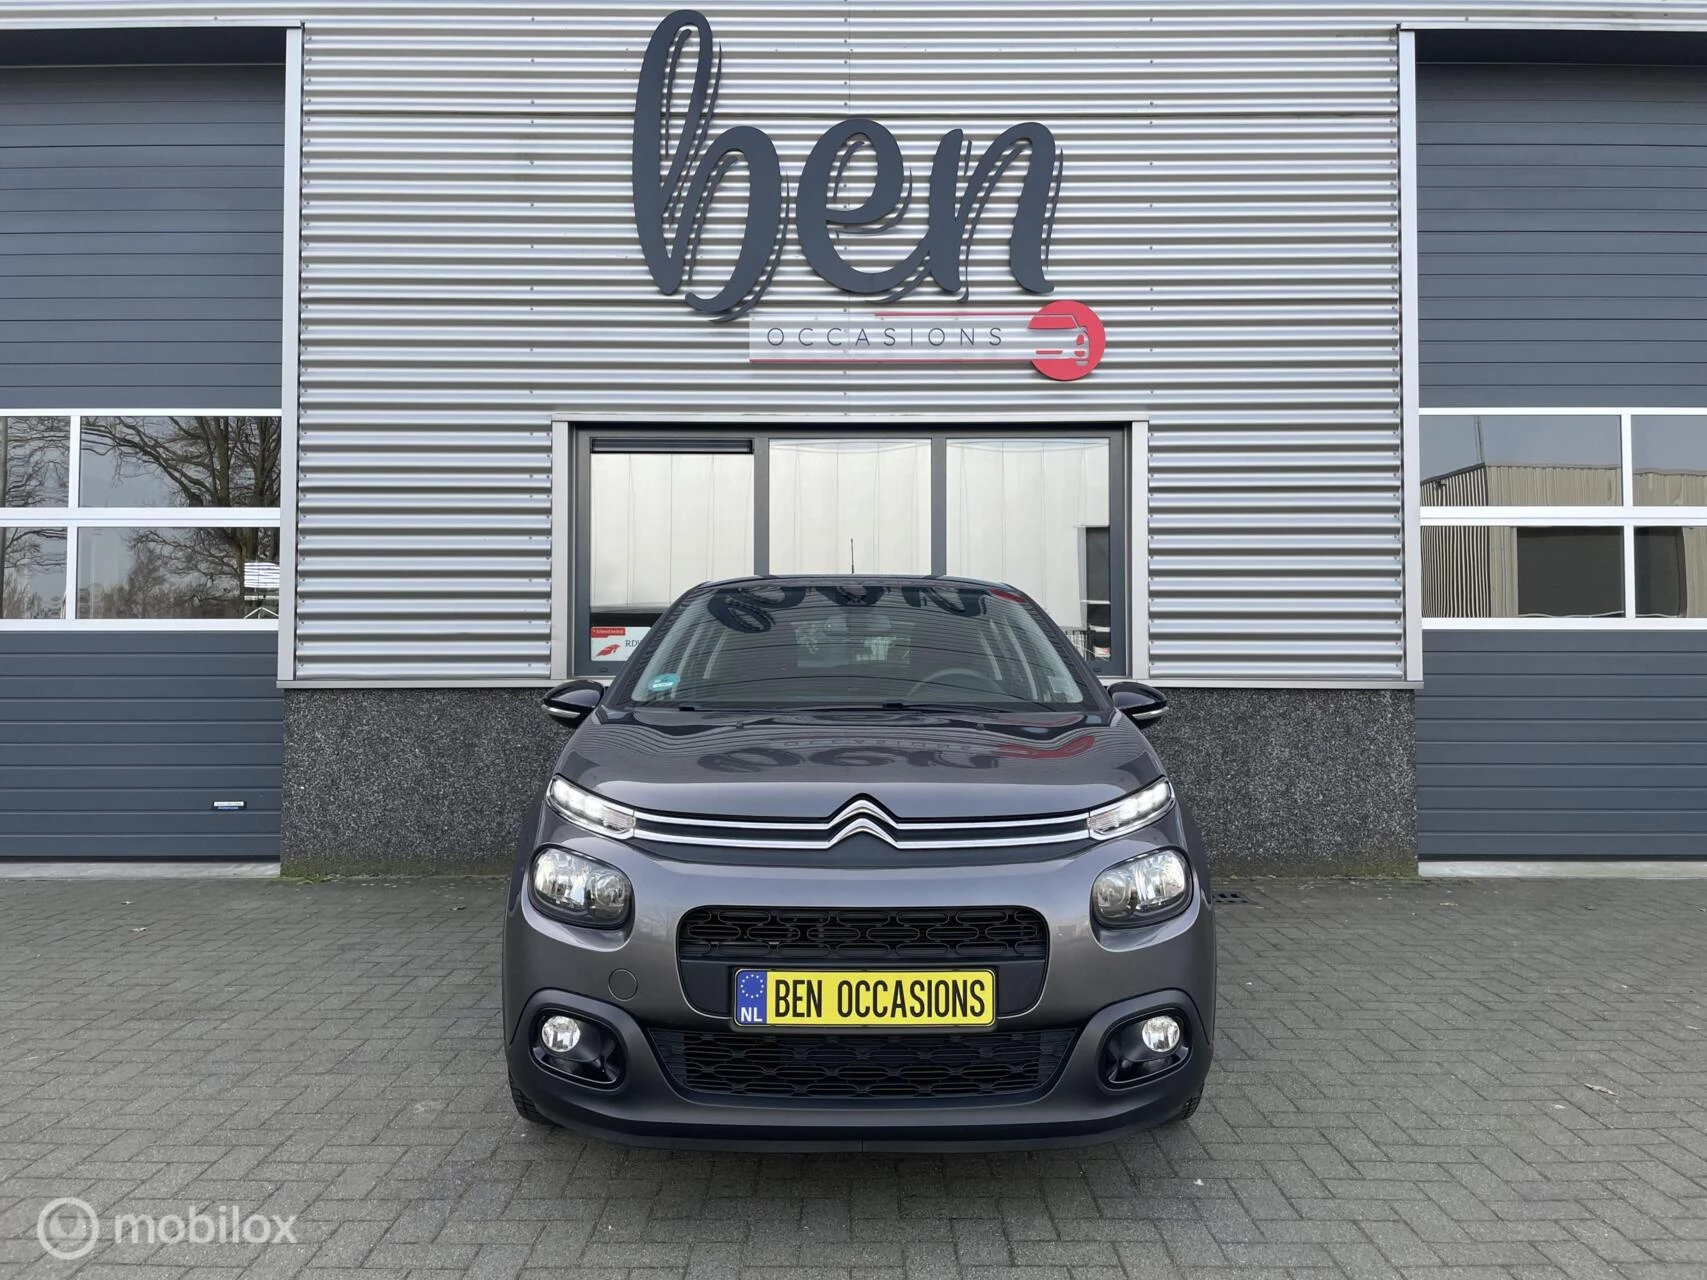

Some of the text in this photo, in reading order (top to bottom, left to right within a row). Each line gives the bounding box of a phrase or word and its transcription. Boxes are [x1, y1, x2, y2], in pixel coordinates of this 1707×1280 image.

[633, 9, 1056, 314] ben
[766, 327, 1002, 347] OCCASIONS
[775, 979, 986, 1018] BEN OCCASIONS
[740, 1007, 762, 1022] NL
